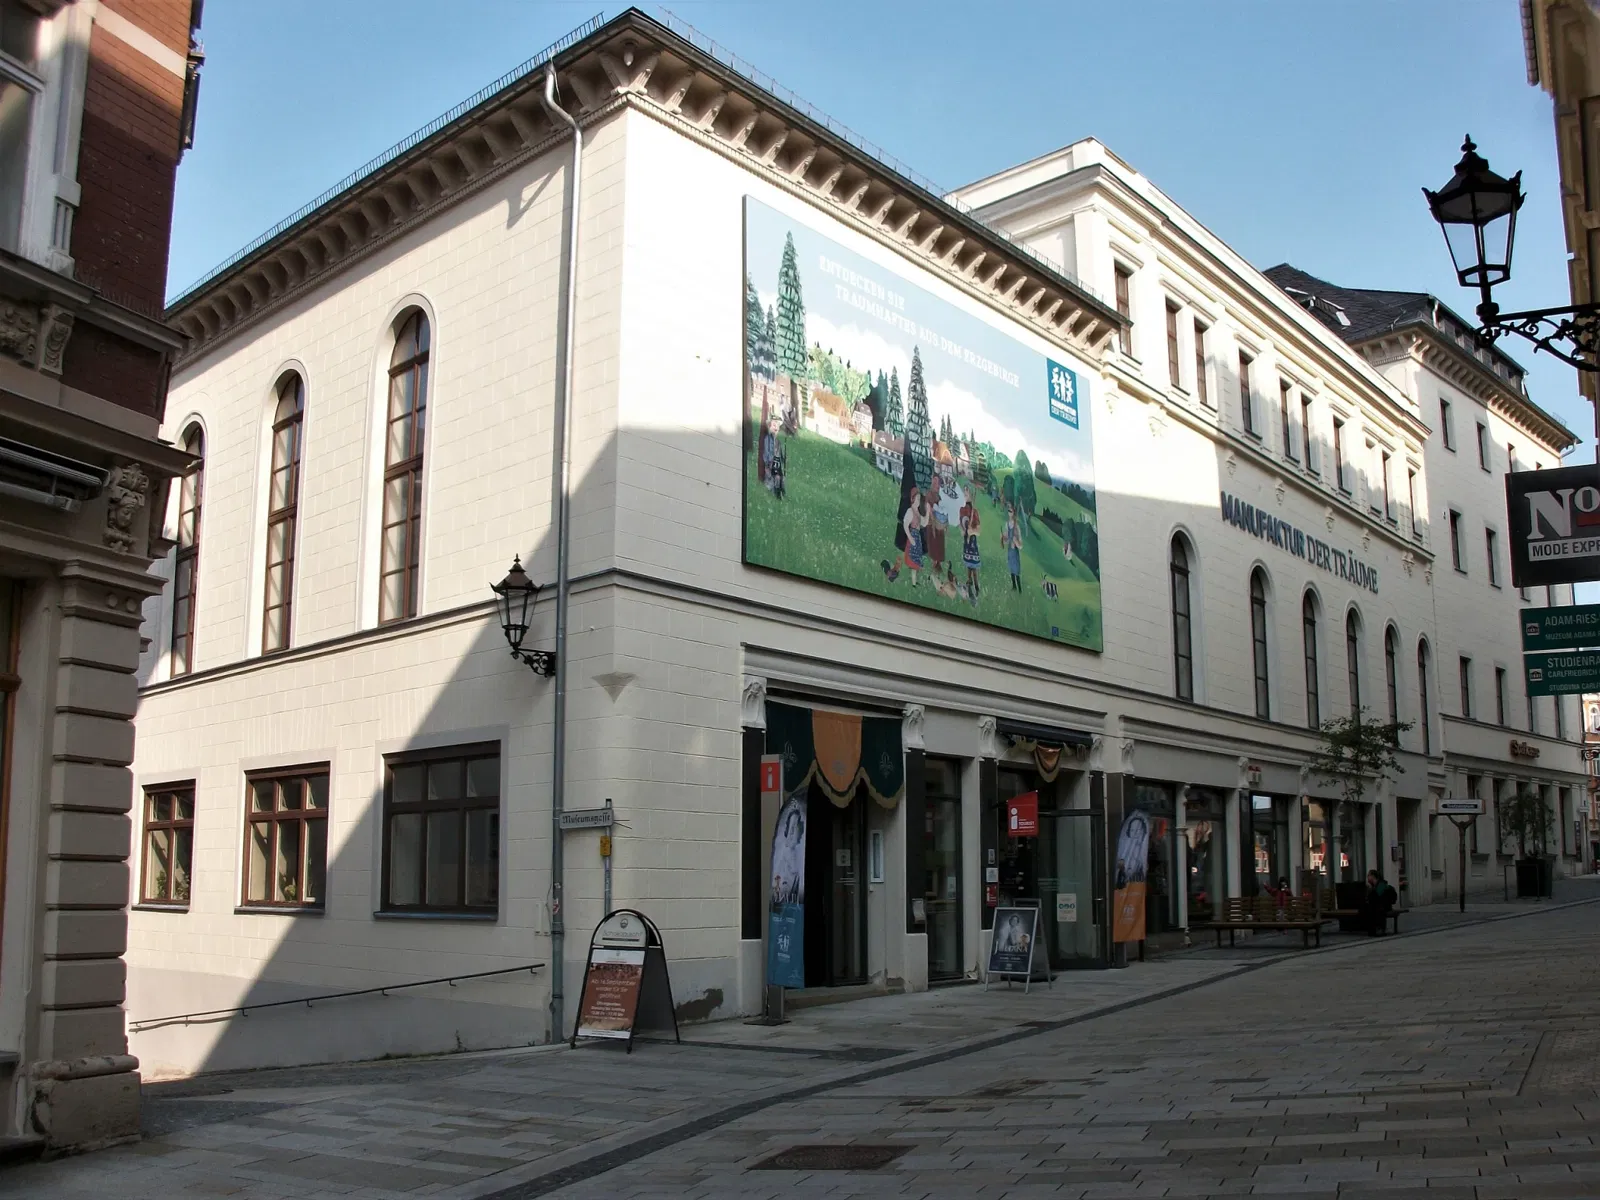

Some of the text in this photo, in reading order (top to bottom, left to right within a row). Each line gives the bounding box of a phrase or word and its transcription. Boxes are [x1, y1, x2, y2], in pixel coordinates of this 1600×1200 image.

[819, 257, 905, 311] ENTDECKEN SIE
[835, 286, 1020, 389] TRAUMHAFTES AUS DEM ERZGEBIRGE
[1221, 490, 1379, 594] MANUFAKTUR DER TRÄUME
[1532, 541, 1570, 557] MODE
